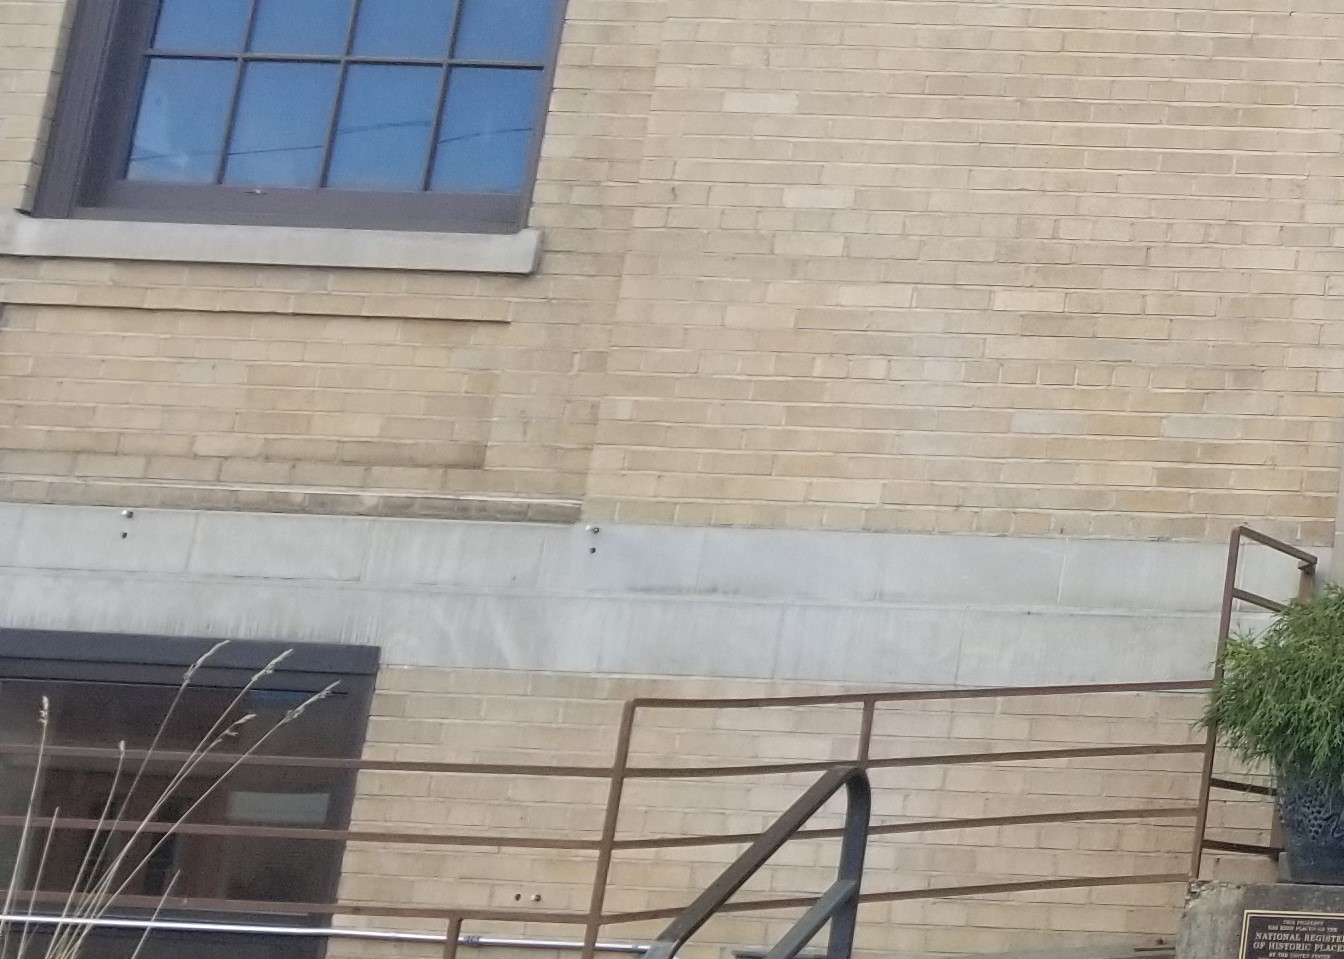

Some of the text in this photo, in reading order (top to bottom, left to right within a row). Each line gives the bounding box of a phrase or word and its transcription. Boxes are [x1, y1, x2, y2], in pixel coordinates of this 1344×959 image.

[1255, 932, 1301, 942] NATIONAL
[1252, 941, 1266, 950] OF
[1268, 941, 1311, 951] HISTORIC
